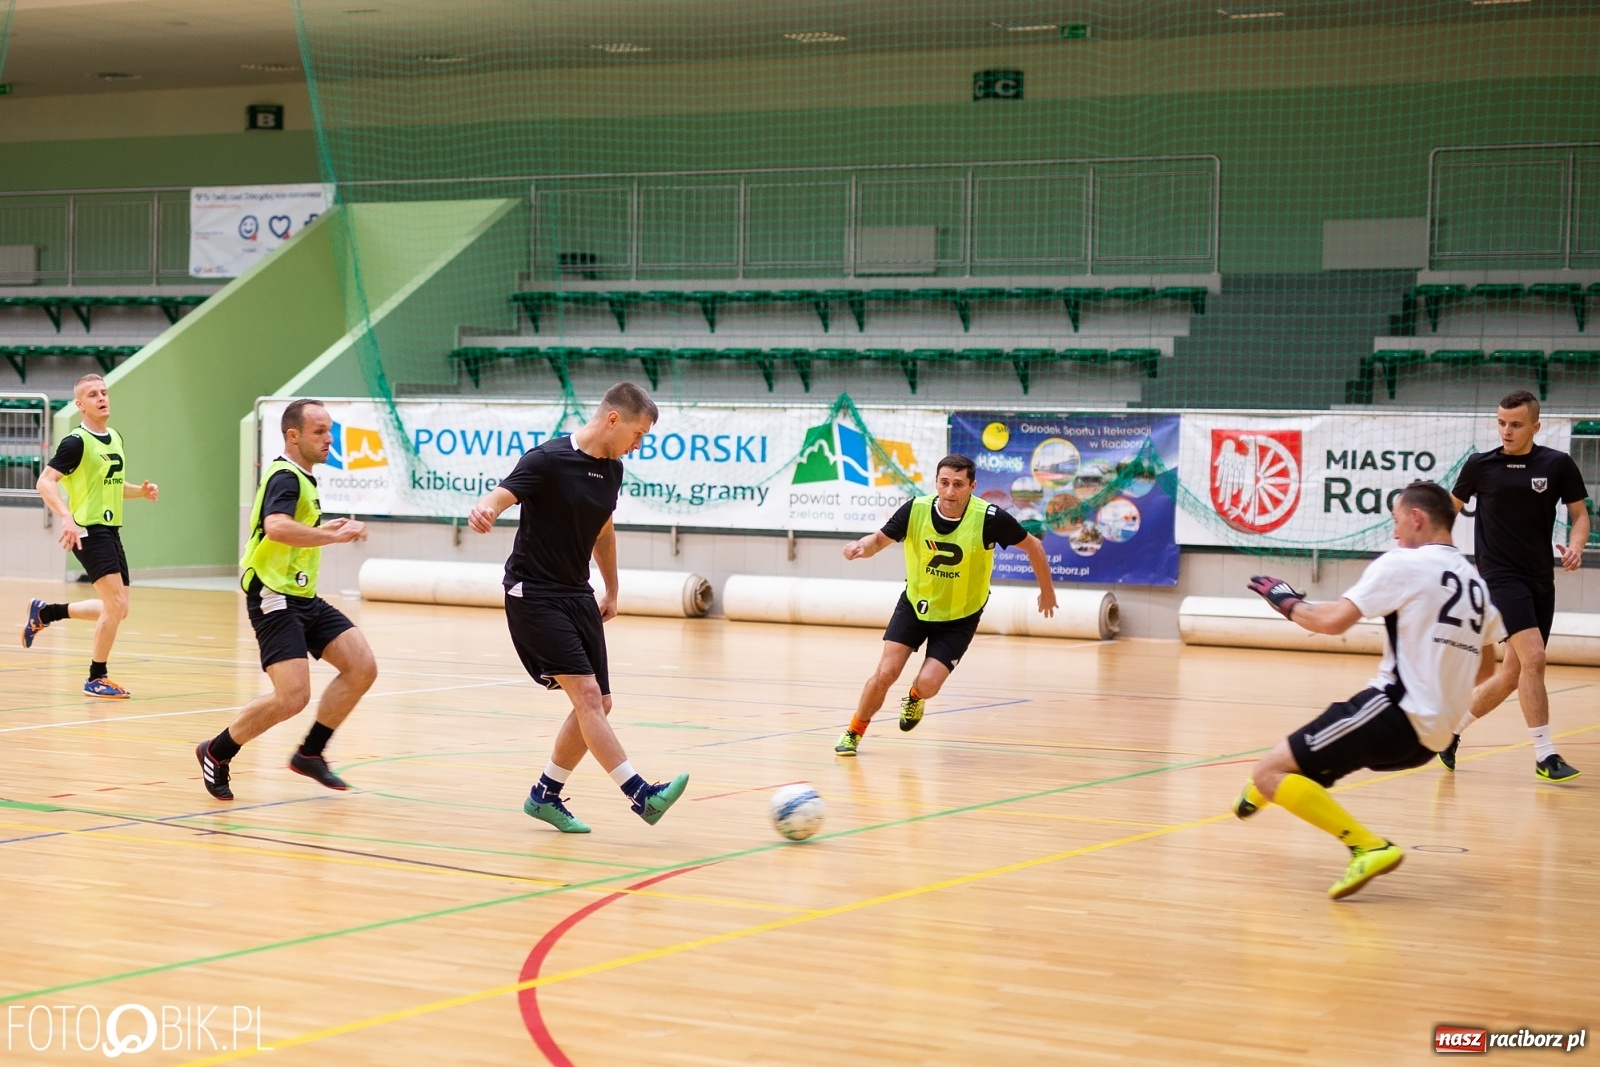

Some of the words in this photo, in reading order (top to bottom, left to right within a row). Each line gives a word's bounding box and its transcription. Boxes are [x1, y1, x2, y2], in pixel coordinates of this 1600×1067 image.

[995, 80, 1017, 97] C
[257, 113, 275, 127] B
[1064, 425, 1095, 437] Sportu
[1103, 424, 1152, 437] Rekreacji
[414, 428, 546, 457] POWIAT
[1326, 449, 1436, 472] MIASTO
[412, 471, 504, 497] kibicuje
[691, 483, 769, 507] gramy
[789, 490, 841, 508] powiat
[789, 509, 835, 520] zielona
[843, 512, 876, 522] oaza
[926, 567, 961, 578] PATRICK
[920, 601, 928, 614] 7
[1438, 570, 1485, 634] 29
